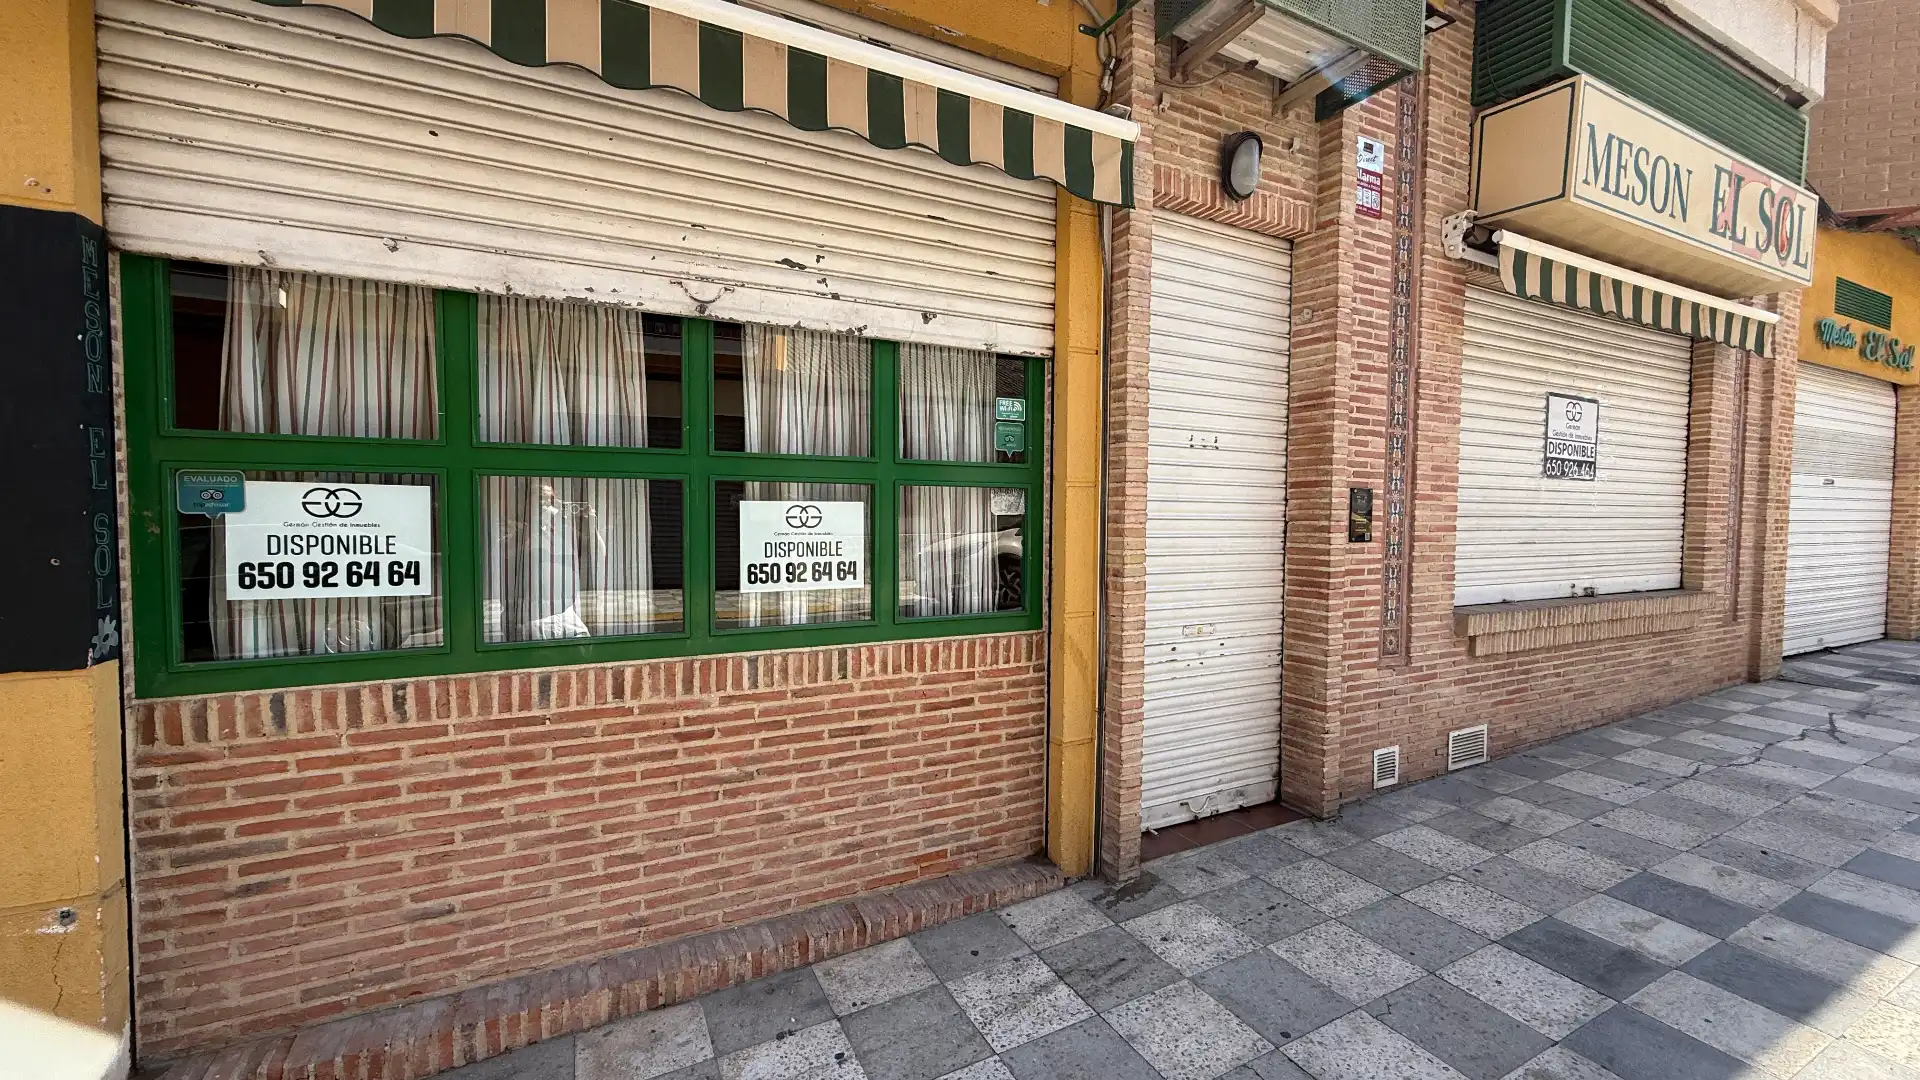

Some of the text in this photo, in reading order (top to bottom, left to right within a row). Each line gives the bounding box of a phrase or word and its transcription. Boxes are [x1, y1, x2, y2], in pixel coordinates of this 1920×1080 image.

[1582, 122, 1808, 270] MESON EL SOL
[1863, 330, 1887, 362] El
[1883, 337, 1916, 372] Sol
[81, 234, 113, 610] MESON EL SOL
[1548, 441, 1595, 459] DISPONIBLE
[183, 475, 238, 483] EVALUADO
[1546, 459, 1595, 479] 650 926 464
[267, 534, 397, 556] DISPONIBLE
[764, 540, 843, 559] DISPONIBLE
[238, 560, 421, 590] 650 92 64 64
[747, 560, 857, 585] 650 92 64 64
